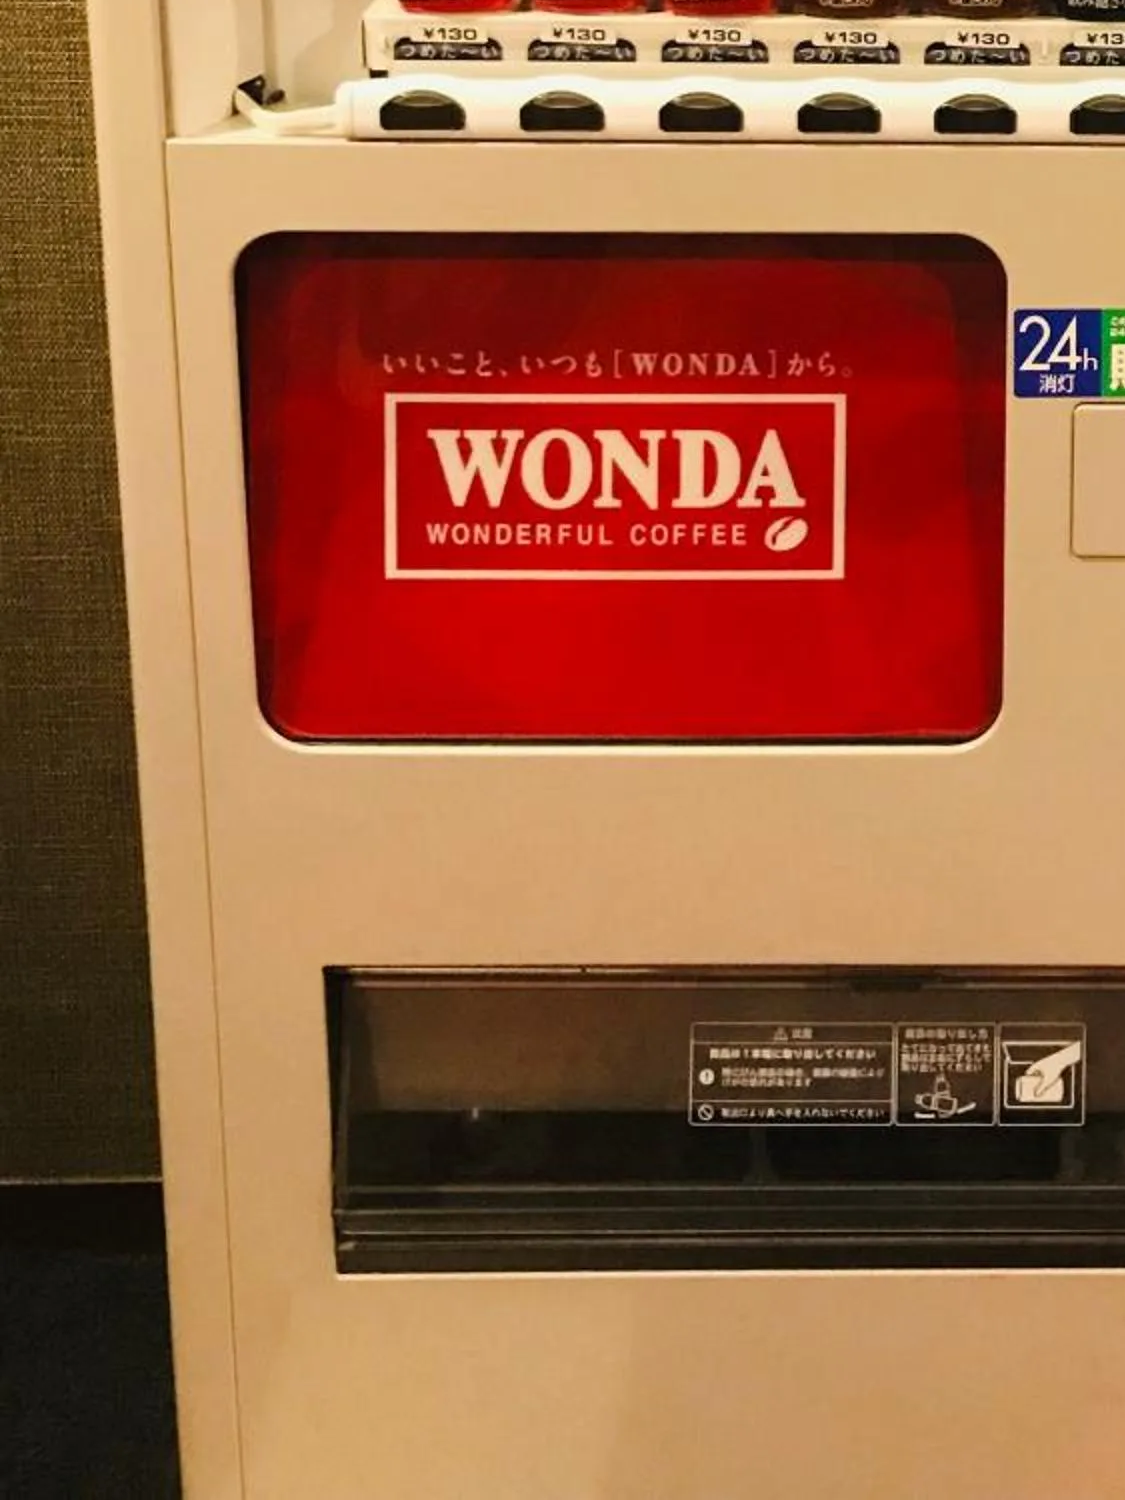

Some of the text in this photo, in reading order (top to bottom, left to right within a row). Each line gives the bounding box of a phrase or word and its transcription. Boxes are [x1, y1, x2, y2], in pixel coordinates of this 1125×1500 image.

[424, 28, 477, 40] ¥130
[552, 28, 605, 40] ¥130
[688, 30, 741, 42] ¥130
[825, 32, 876, 44] ¥130
[958, 33, 1009, 44] ¥130
[1018, 315, 1098, 371] 24h
[1039, 374, 1075, 393] 消灯
[427, 428, 806, 509] WONDA
[426, 523, 747, 546] WONDERFUL COFFEE
